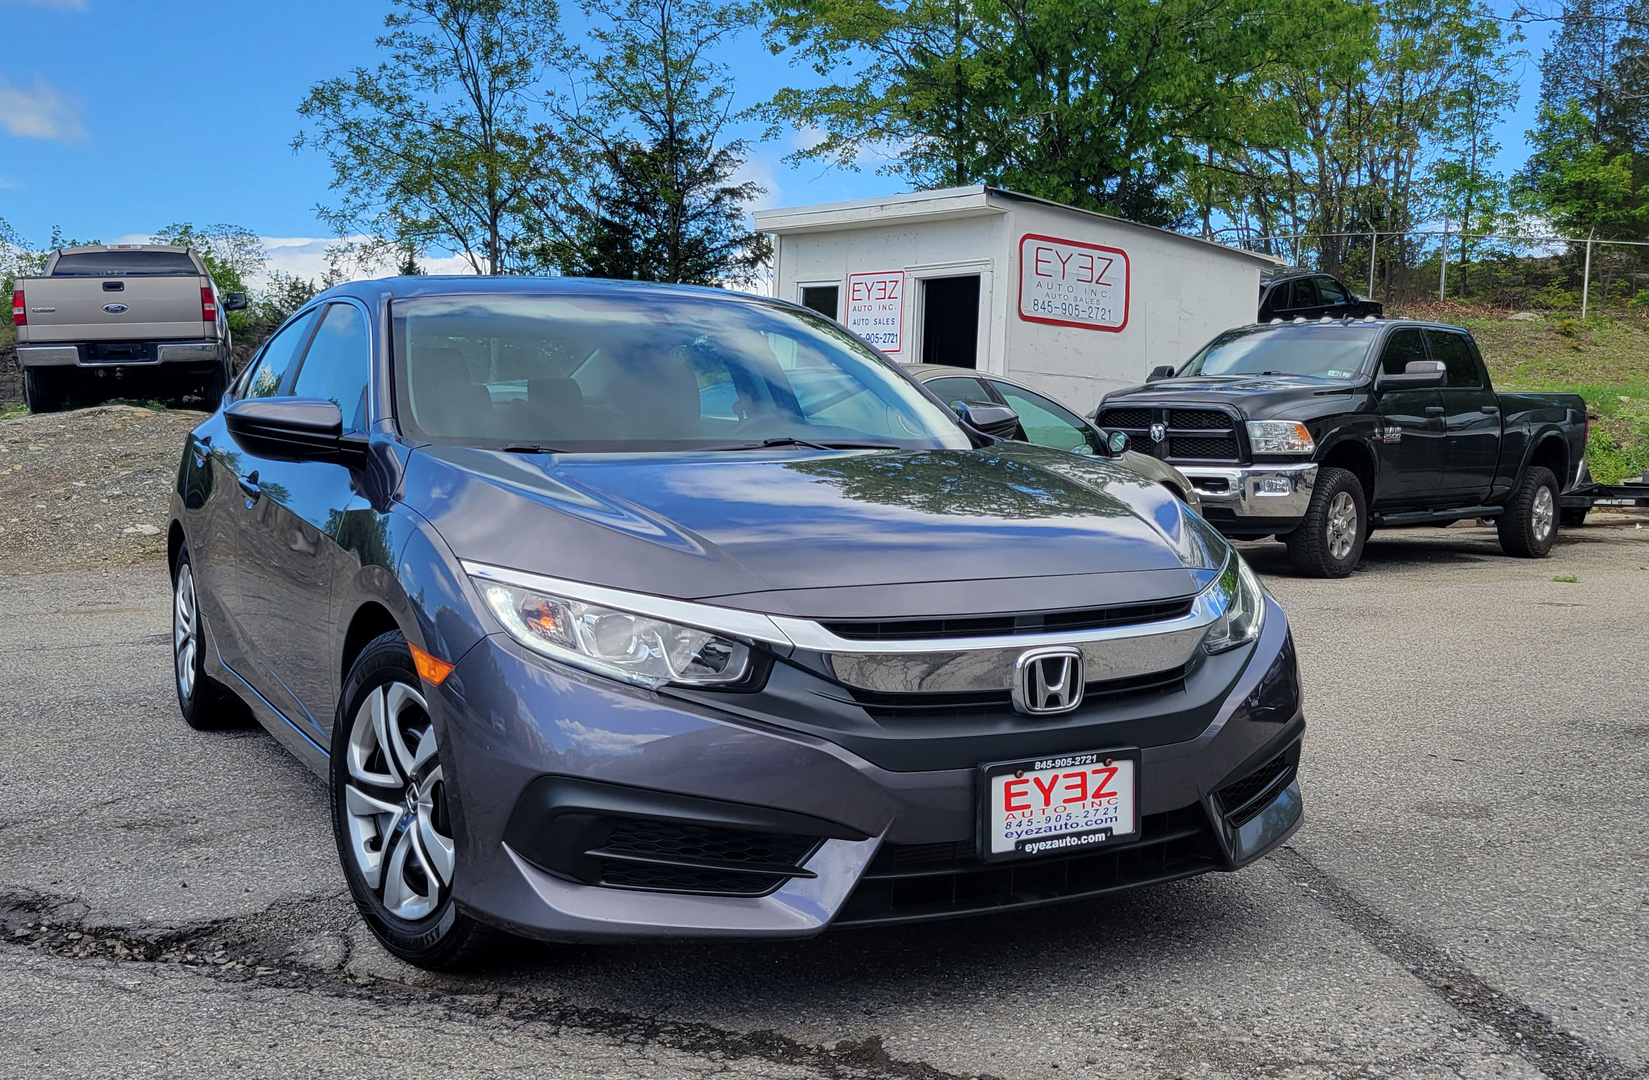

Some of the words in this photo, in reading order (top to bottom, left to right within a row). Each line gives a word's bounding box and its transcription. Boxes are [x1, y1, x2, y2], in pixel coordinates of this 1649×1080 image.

[1036, 281, 1075, 293] AUTO
[1084, 287, 1111, 299] INC.
[1045, 292, 1069, 301] AUTO
[1073, 295, 1101, 306] SALES
[852, 304, 873, 312] AUTO
[878, 303, 897, 311] INC.
[1032, 298, 1112, 321] 845-905-2721
[852, 318, 870, 326] AUTO
[873, 317, 896, 326] SALES
[858, 332, 898, 344] -905-2721
[1034, 754, 1098, 770] 845-905-2721
[1004, 805, 1067, 821] AUTO
[1082, 797, 1119, 810] INC
[1004, 806, 1119, 830] 845-905-2721
[1004, 814, 1119, 840] eyezauto.com
[1024, 831, 1106, 854] eyezauto.com
